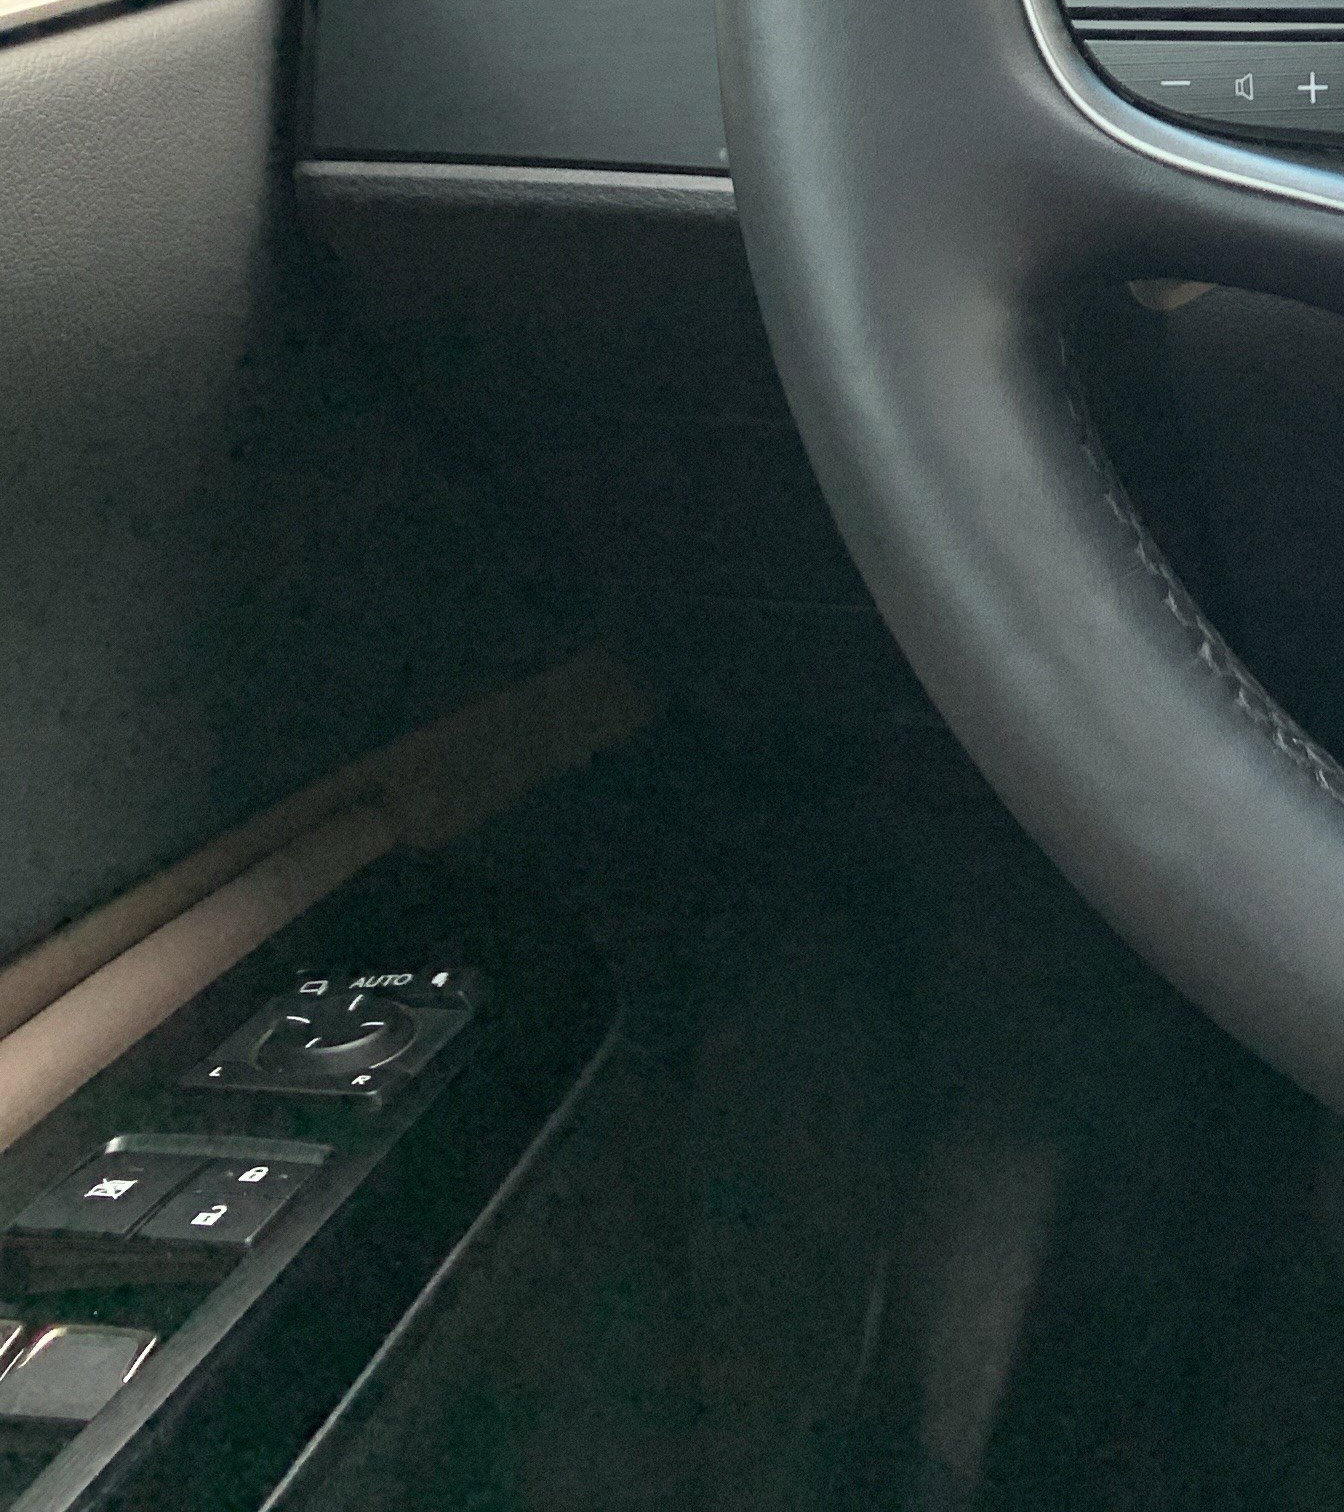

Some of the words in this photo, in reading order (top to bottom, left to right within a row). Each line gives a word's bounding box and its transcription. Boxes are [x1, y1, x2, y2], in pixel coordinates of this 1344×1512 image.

[349, 973, 414, 990] AUTO
[208, 1066, 223, 1077] L
[351, 1074, 372, 1086] R
